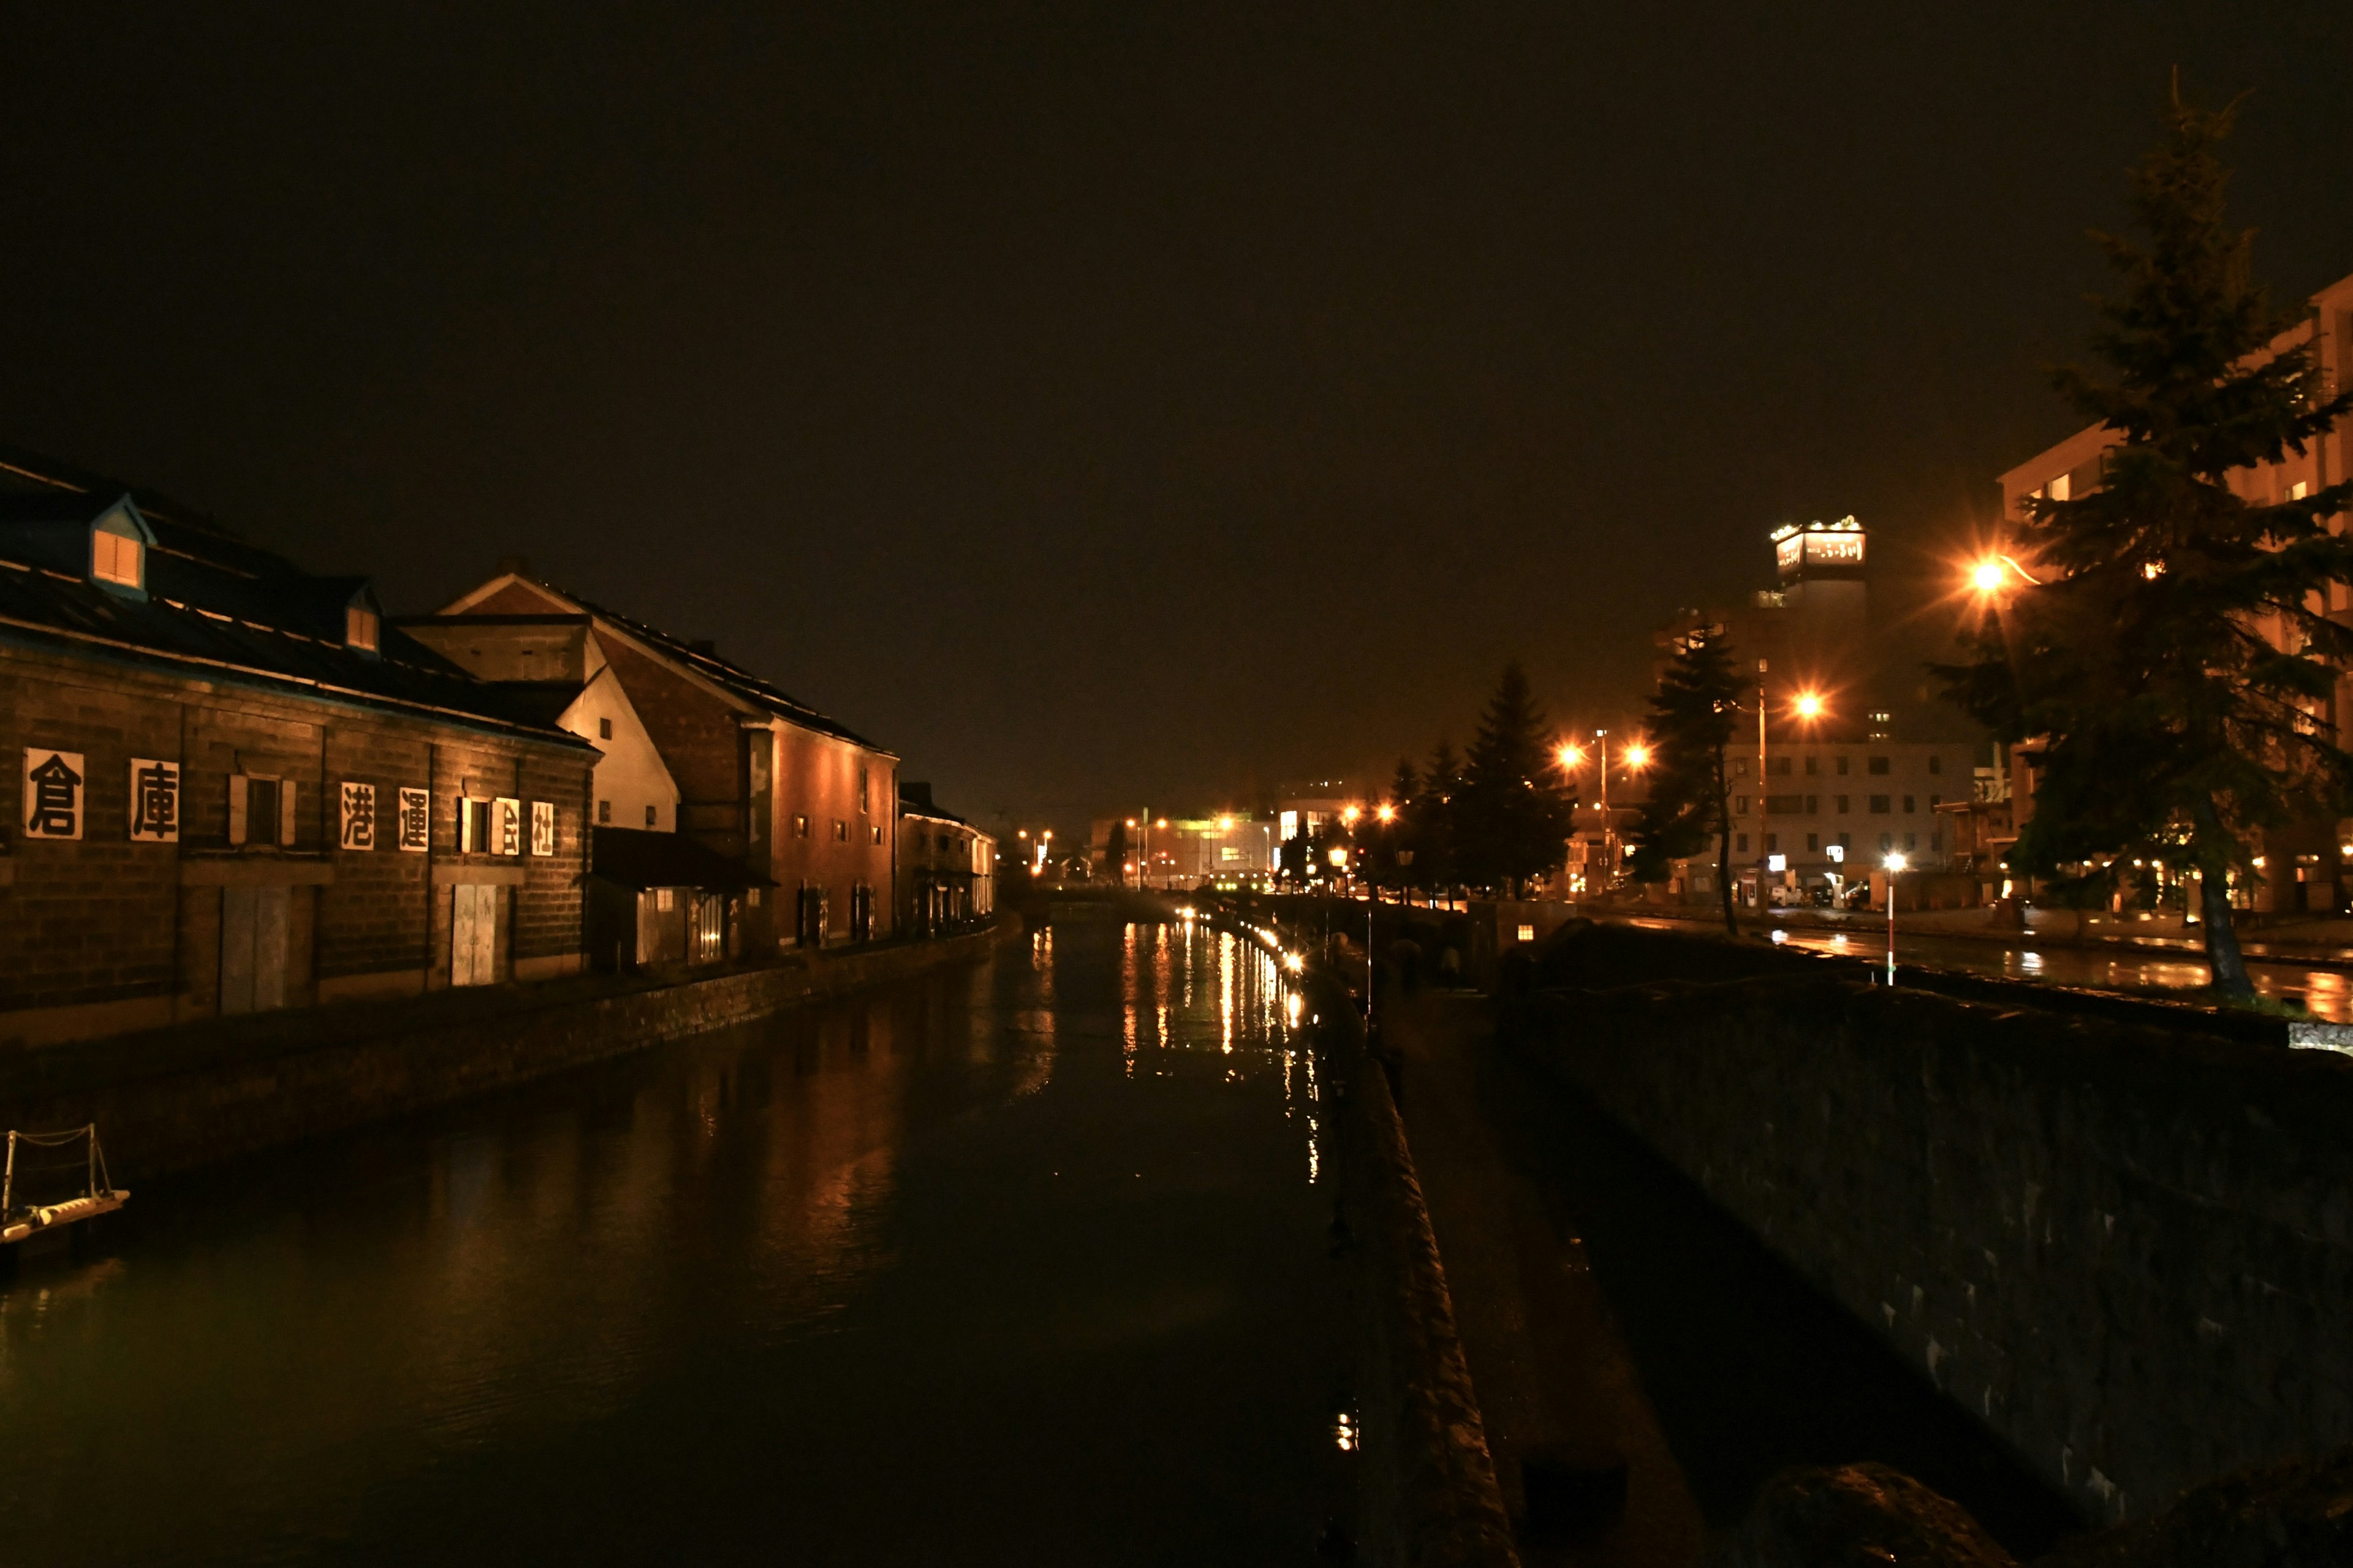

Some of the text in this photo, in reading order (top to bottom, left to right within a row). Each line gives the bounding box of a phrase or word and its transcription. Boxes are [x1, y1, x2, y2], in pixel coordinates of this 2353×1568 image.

[29, 754, 82, 836] 倉
[134, 762, 178, 839] 庫
[344, 785, 373, 846] 港
[402, 790, 427, 847] 運
